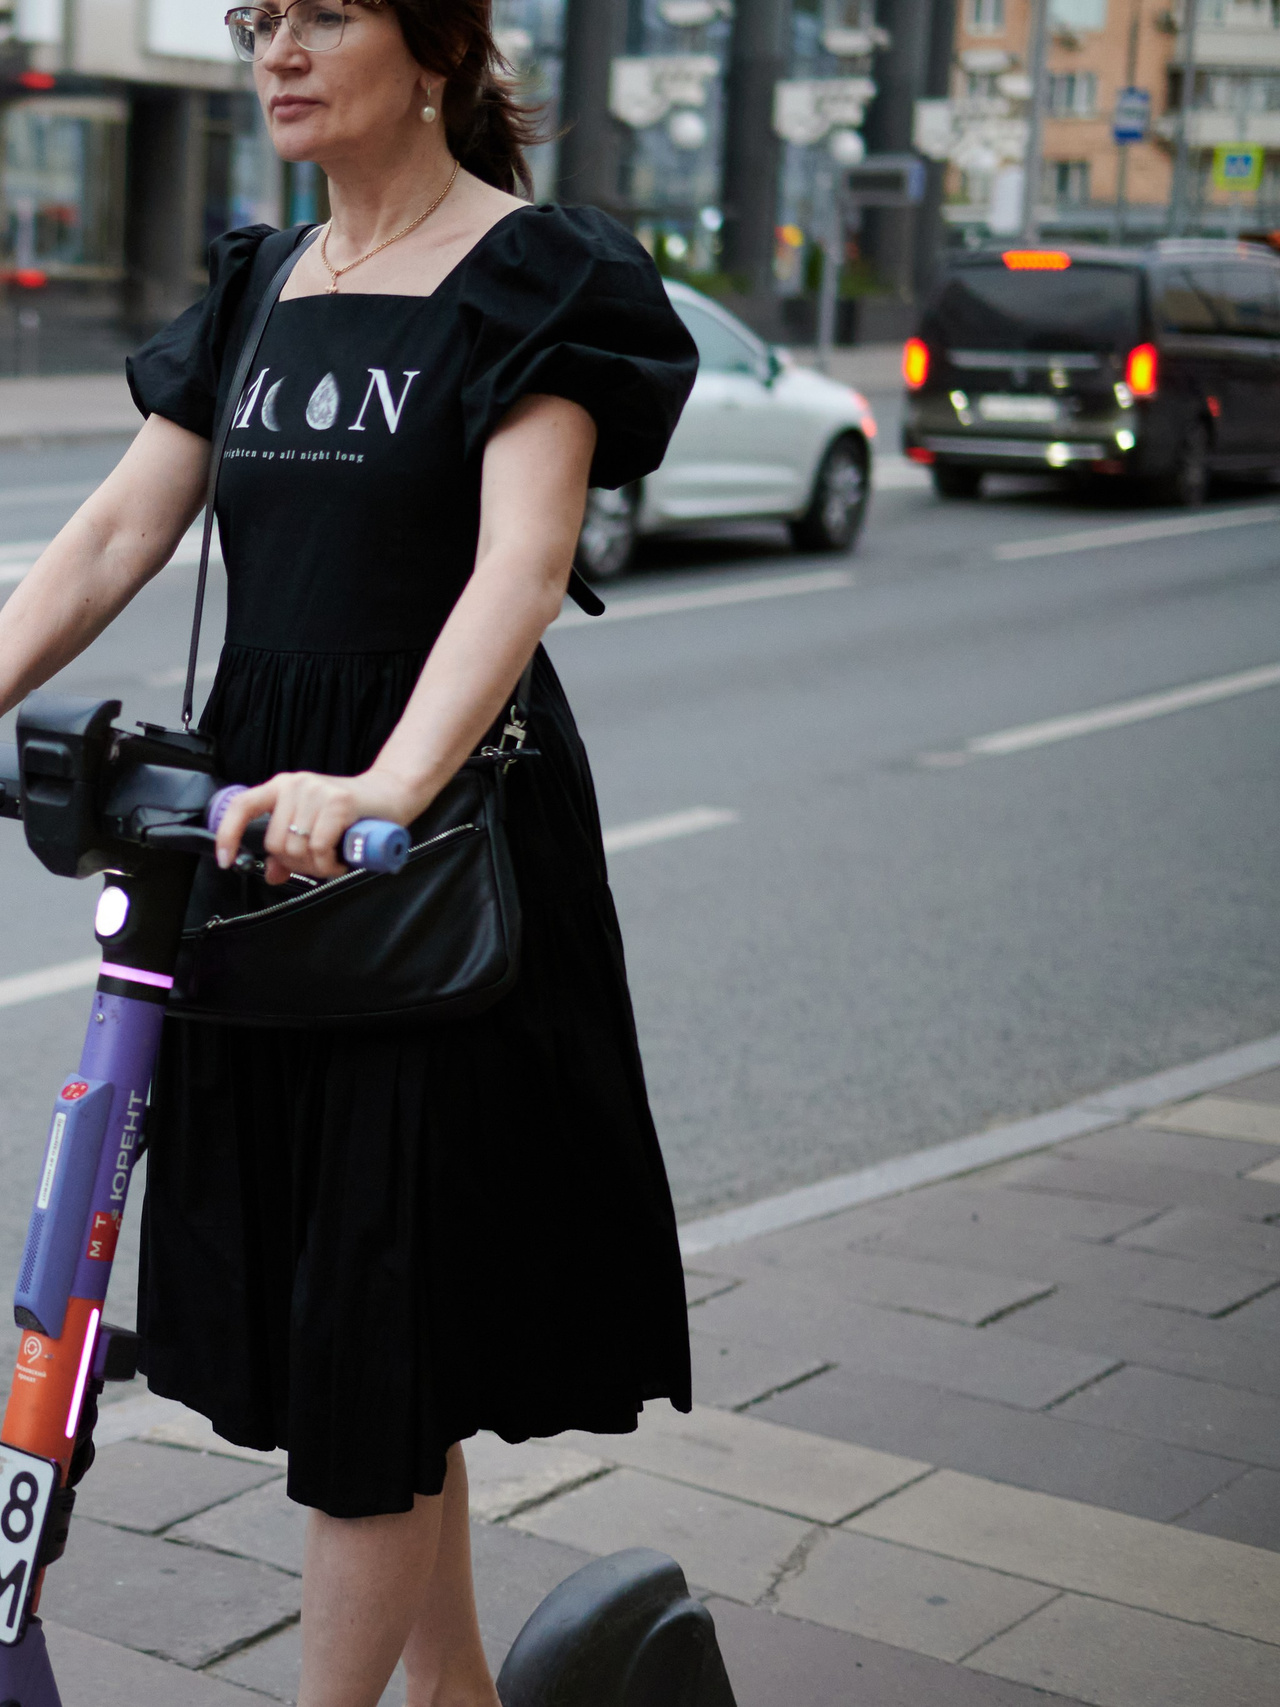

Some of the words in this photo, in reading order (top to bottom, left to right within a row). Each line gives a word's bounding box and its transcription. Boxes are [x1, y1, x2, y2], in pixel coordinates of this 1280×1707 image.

[262, 450, 275, 460] up
[279, 449, 295, 460] all
[300, 450, 330, 462] night
[335, 450, 365, 463] long
[109, 1089, 143, 1201] ЮРЕНТ
